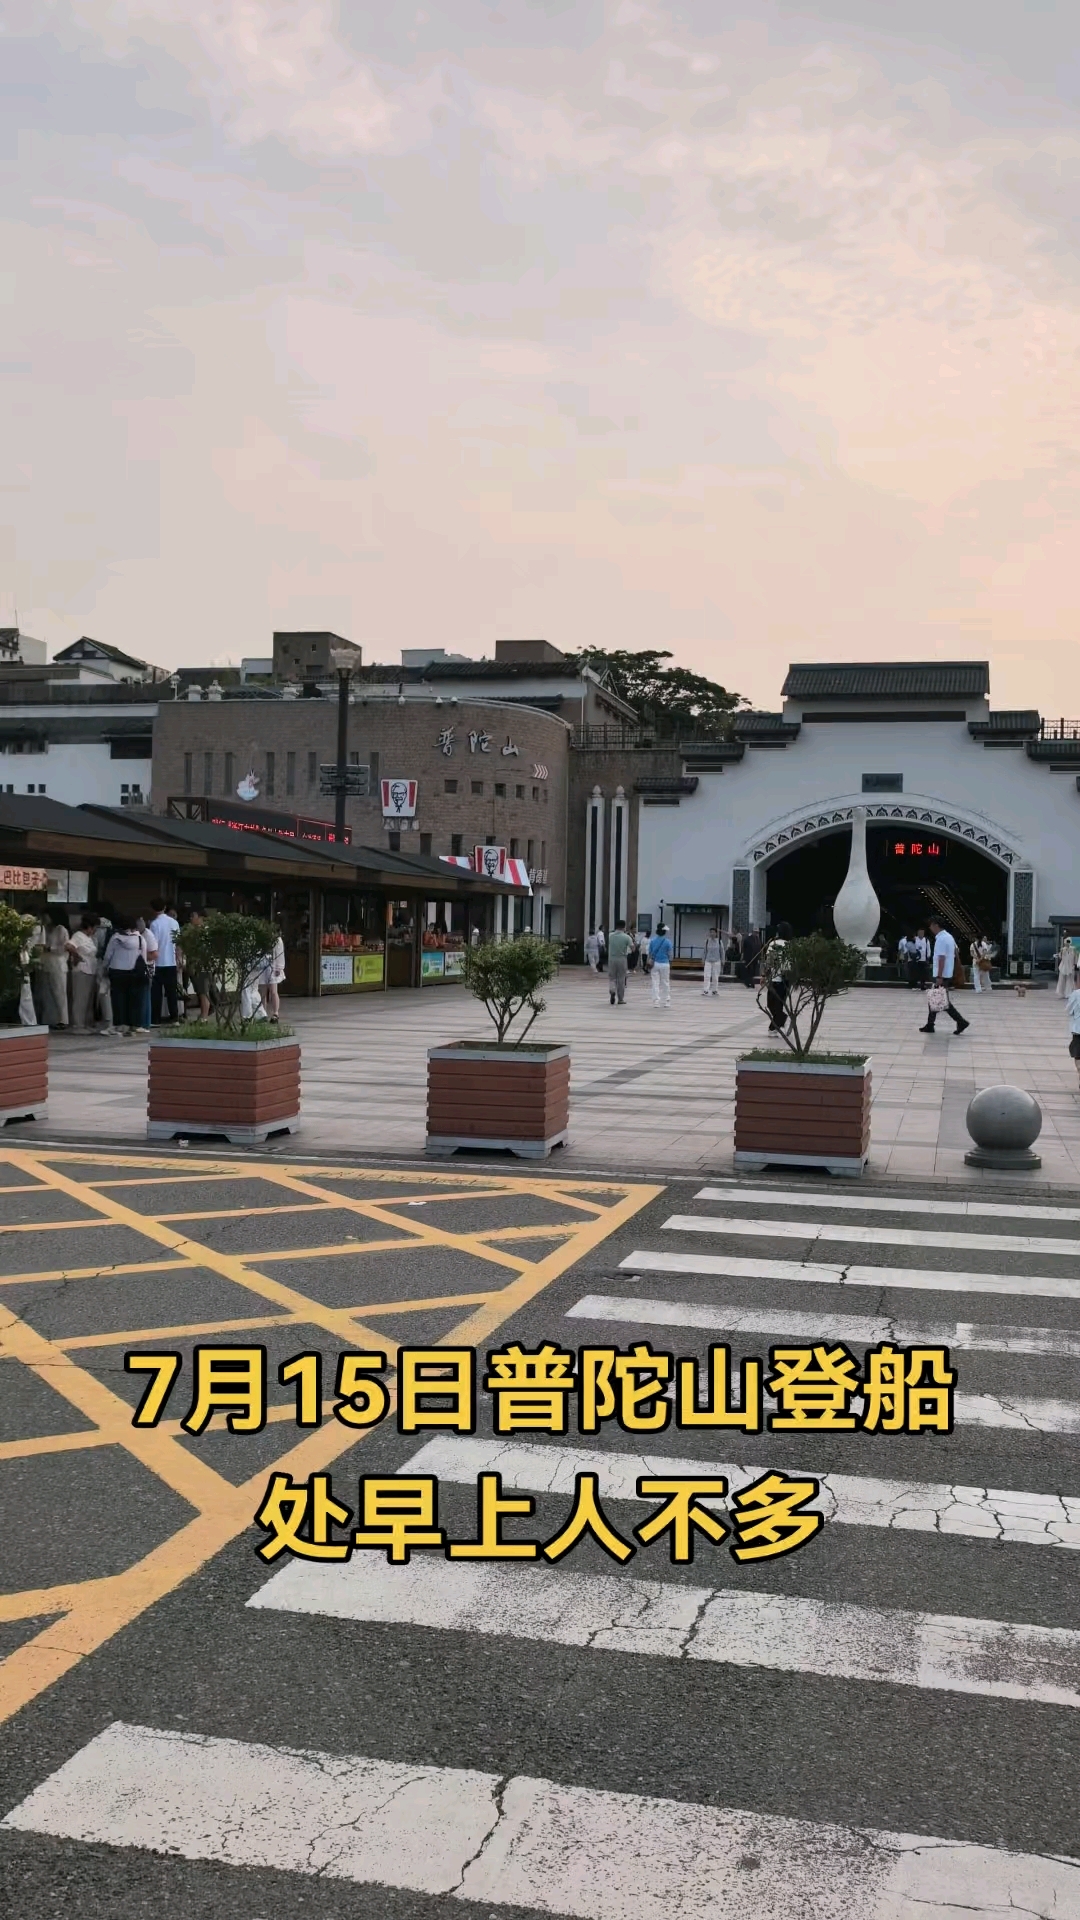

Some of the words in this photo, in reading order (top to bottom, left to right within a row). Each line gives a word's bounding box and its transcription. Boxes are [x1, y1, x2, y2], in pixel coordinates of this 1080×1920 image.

[432, 726, 519, 757] 普陀山
[894, 842, 940, 855] 普陀山
